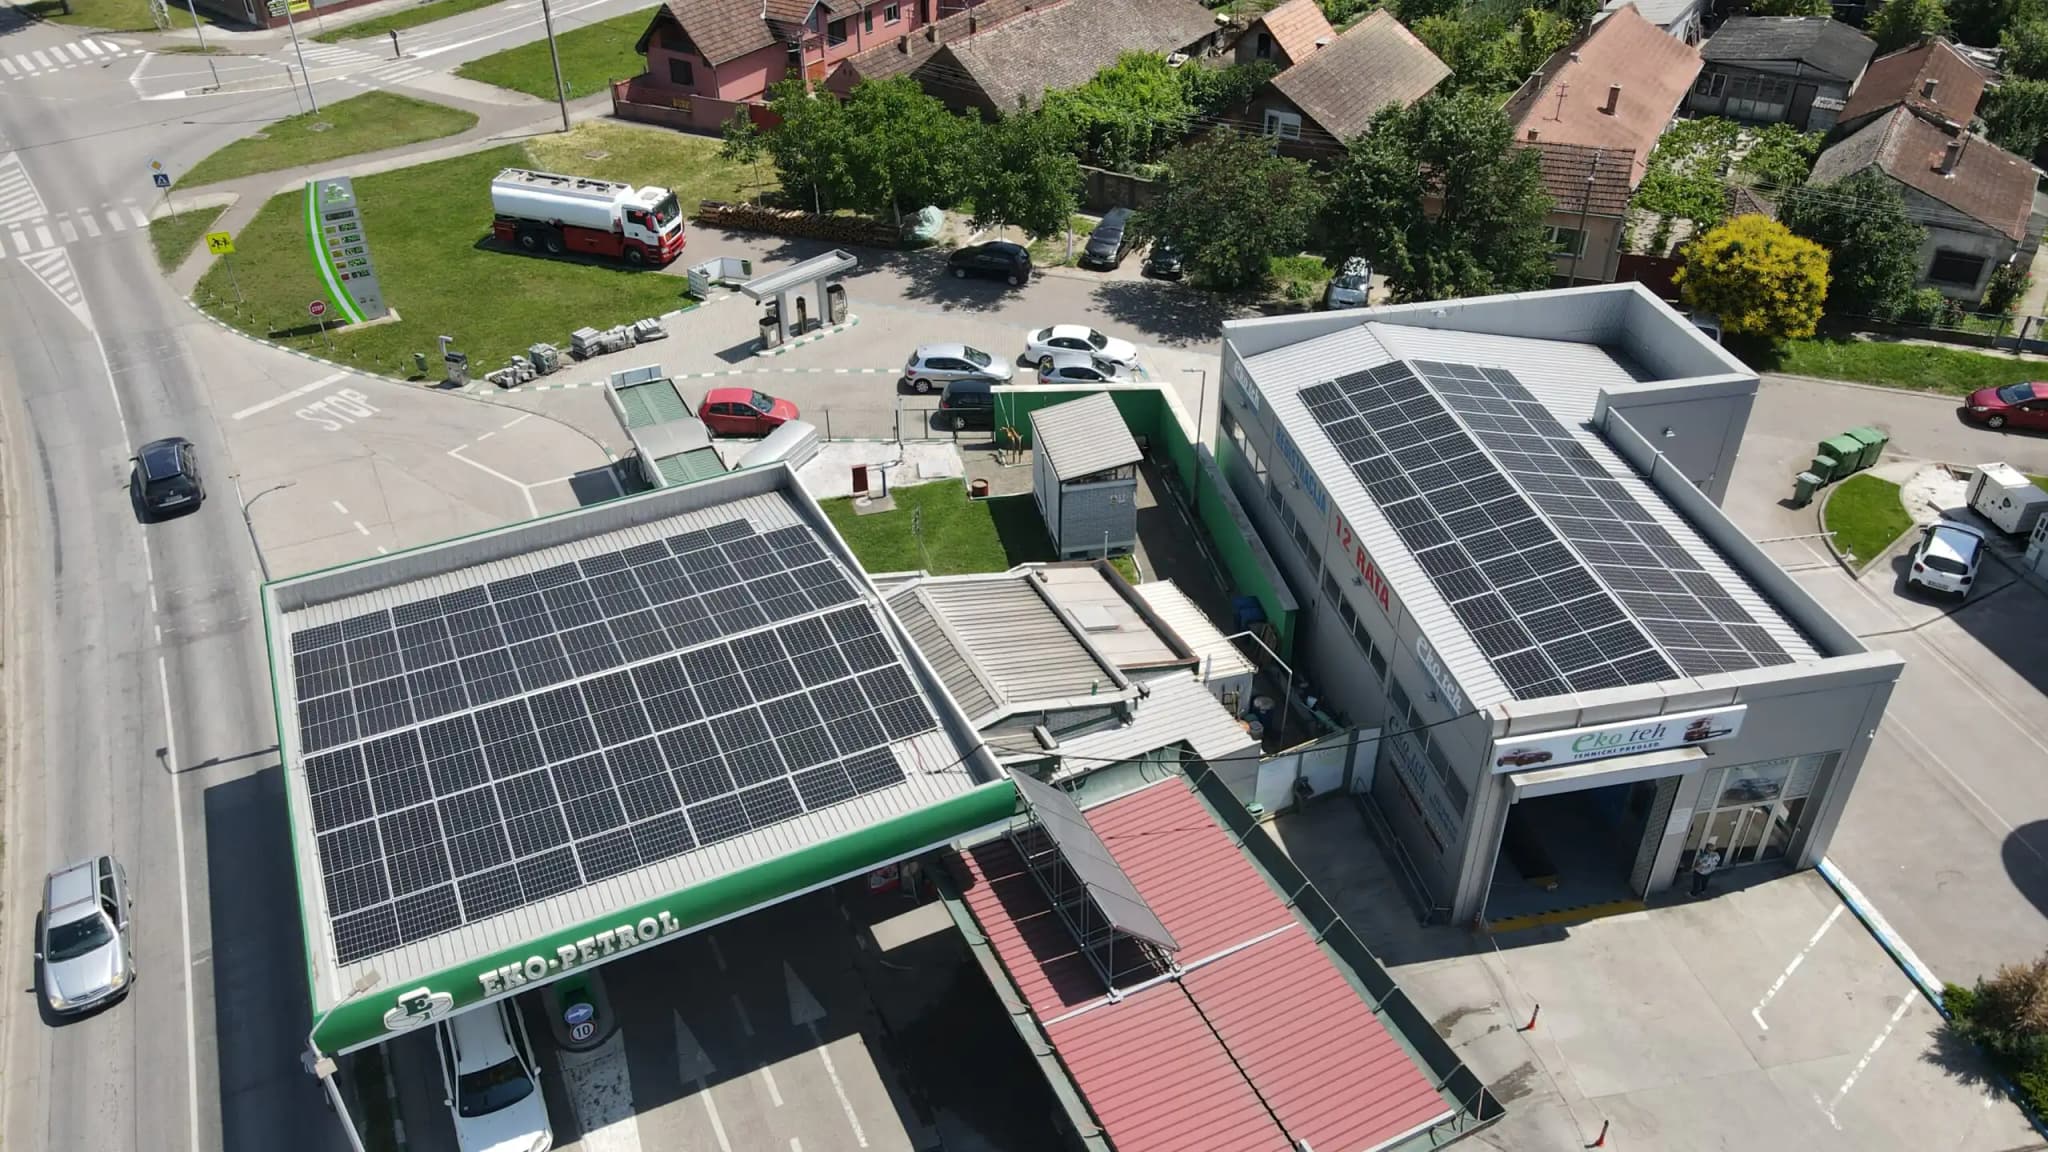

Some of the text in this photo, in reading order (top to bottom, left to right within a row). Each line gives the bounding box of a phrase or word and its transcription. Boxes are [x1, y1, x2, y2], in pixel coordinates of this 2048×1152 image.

[295, 388, 381, 431] STOP
[1336, 516, 1390, 612] 12 RATA
[1416, 635, 1463, 712] eko teh
[1571, 723, 1667, 752] eko teh
[479, 911, 680, 997] EKO-PETROL
[576, 1024, 591, 1038] 10
